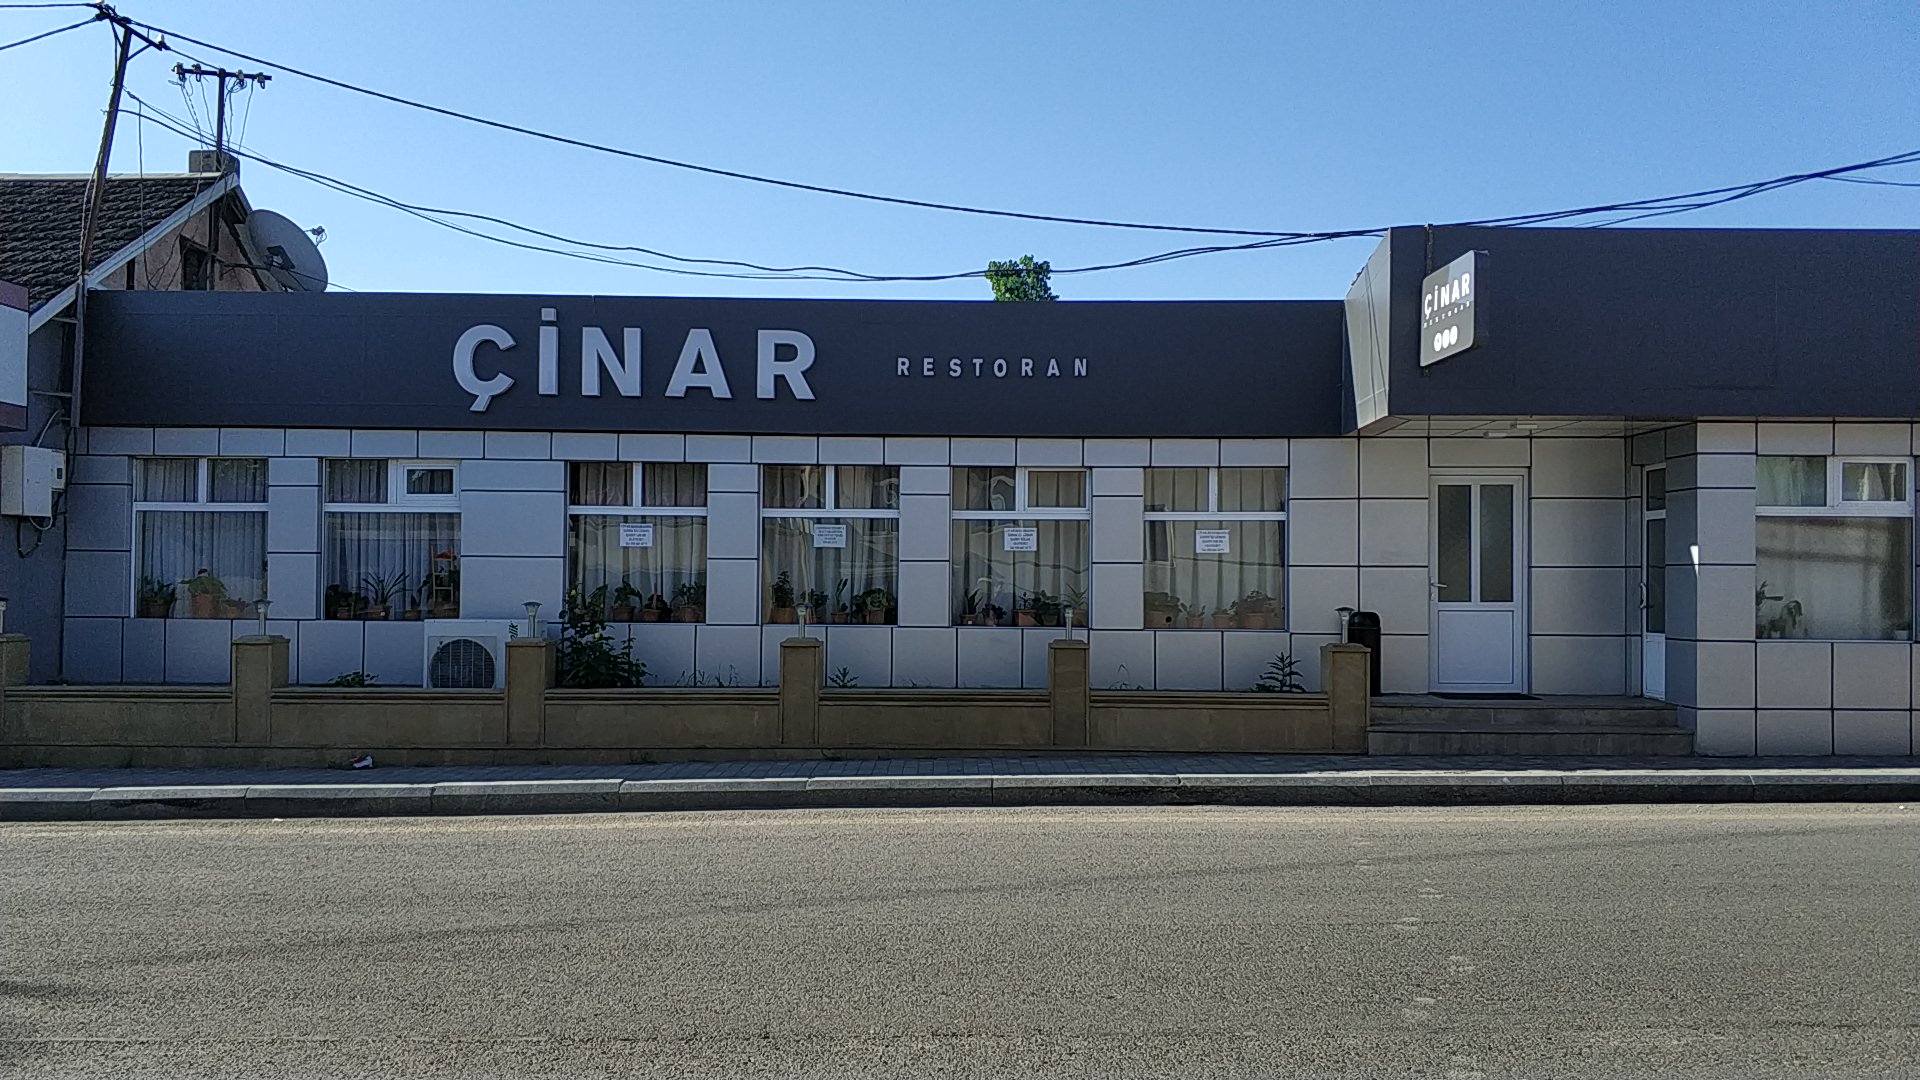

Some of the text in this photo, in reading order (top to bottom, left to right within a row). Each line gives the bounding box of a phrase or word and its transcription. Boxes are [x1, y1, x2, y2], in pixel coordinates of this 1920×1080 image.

[1424, 272, 1470, 320] ÇİNAR
[452, 307, 1087, 412] ÇİNAR RESTORAN
